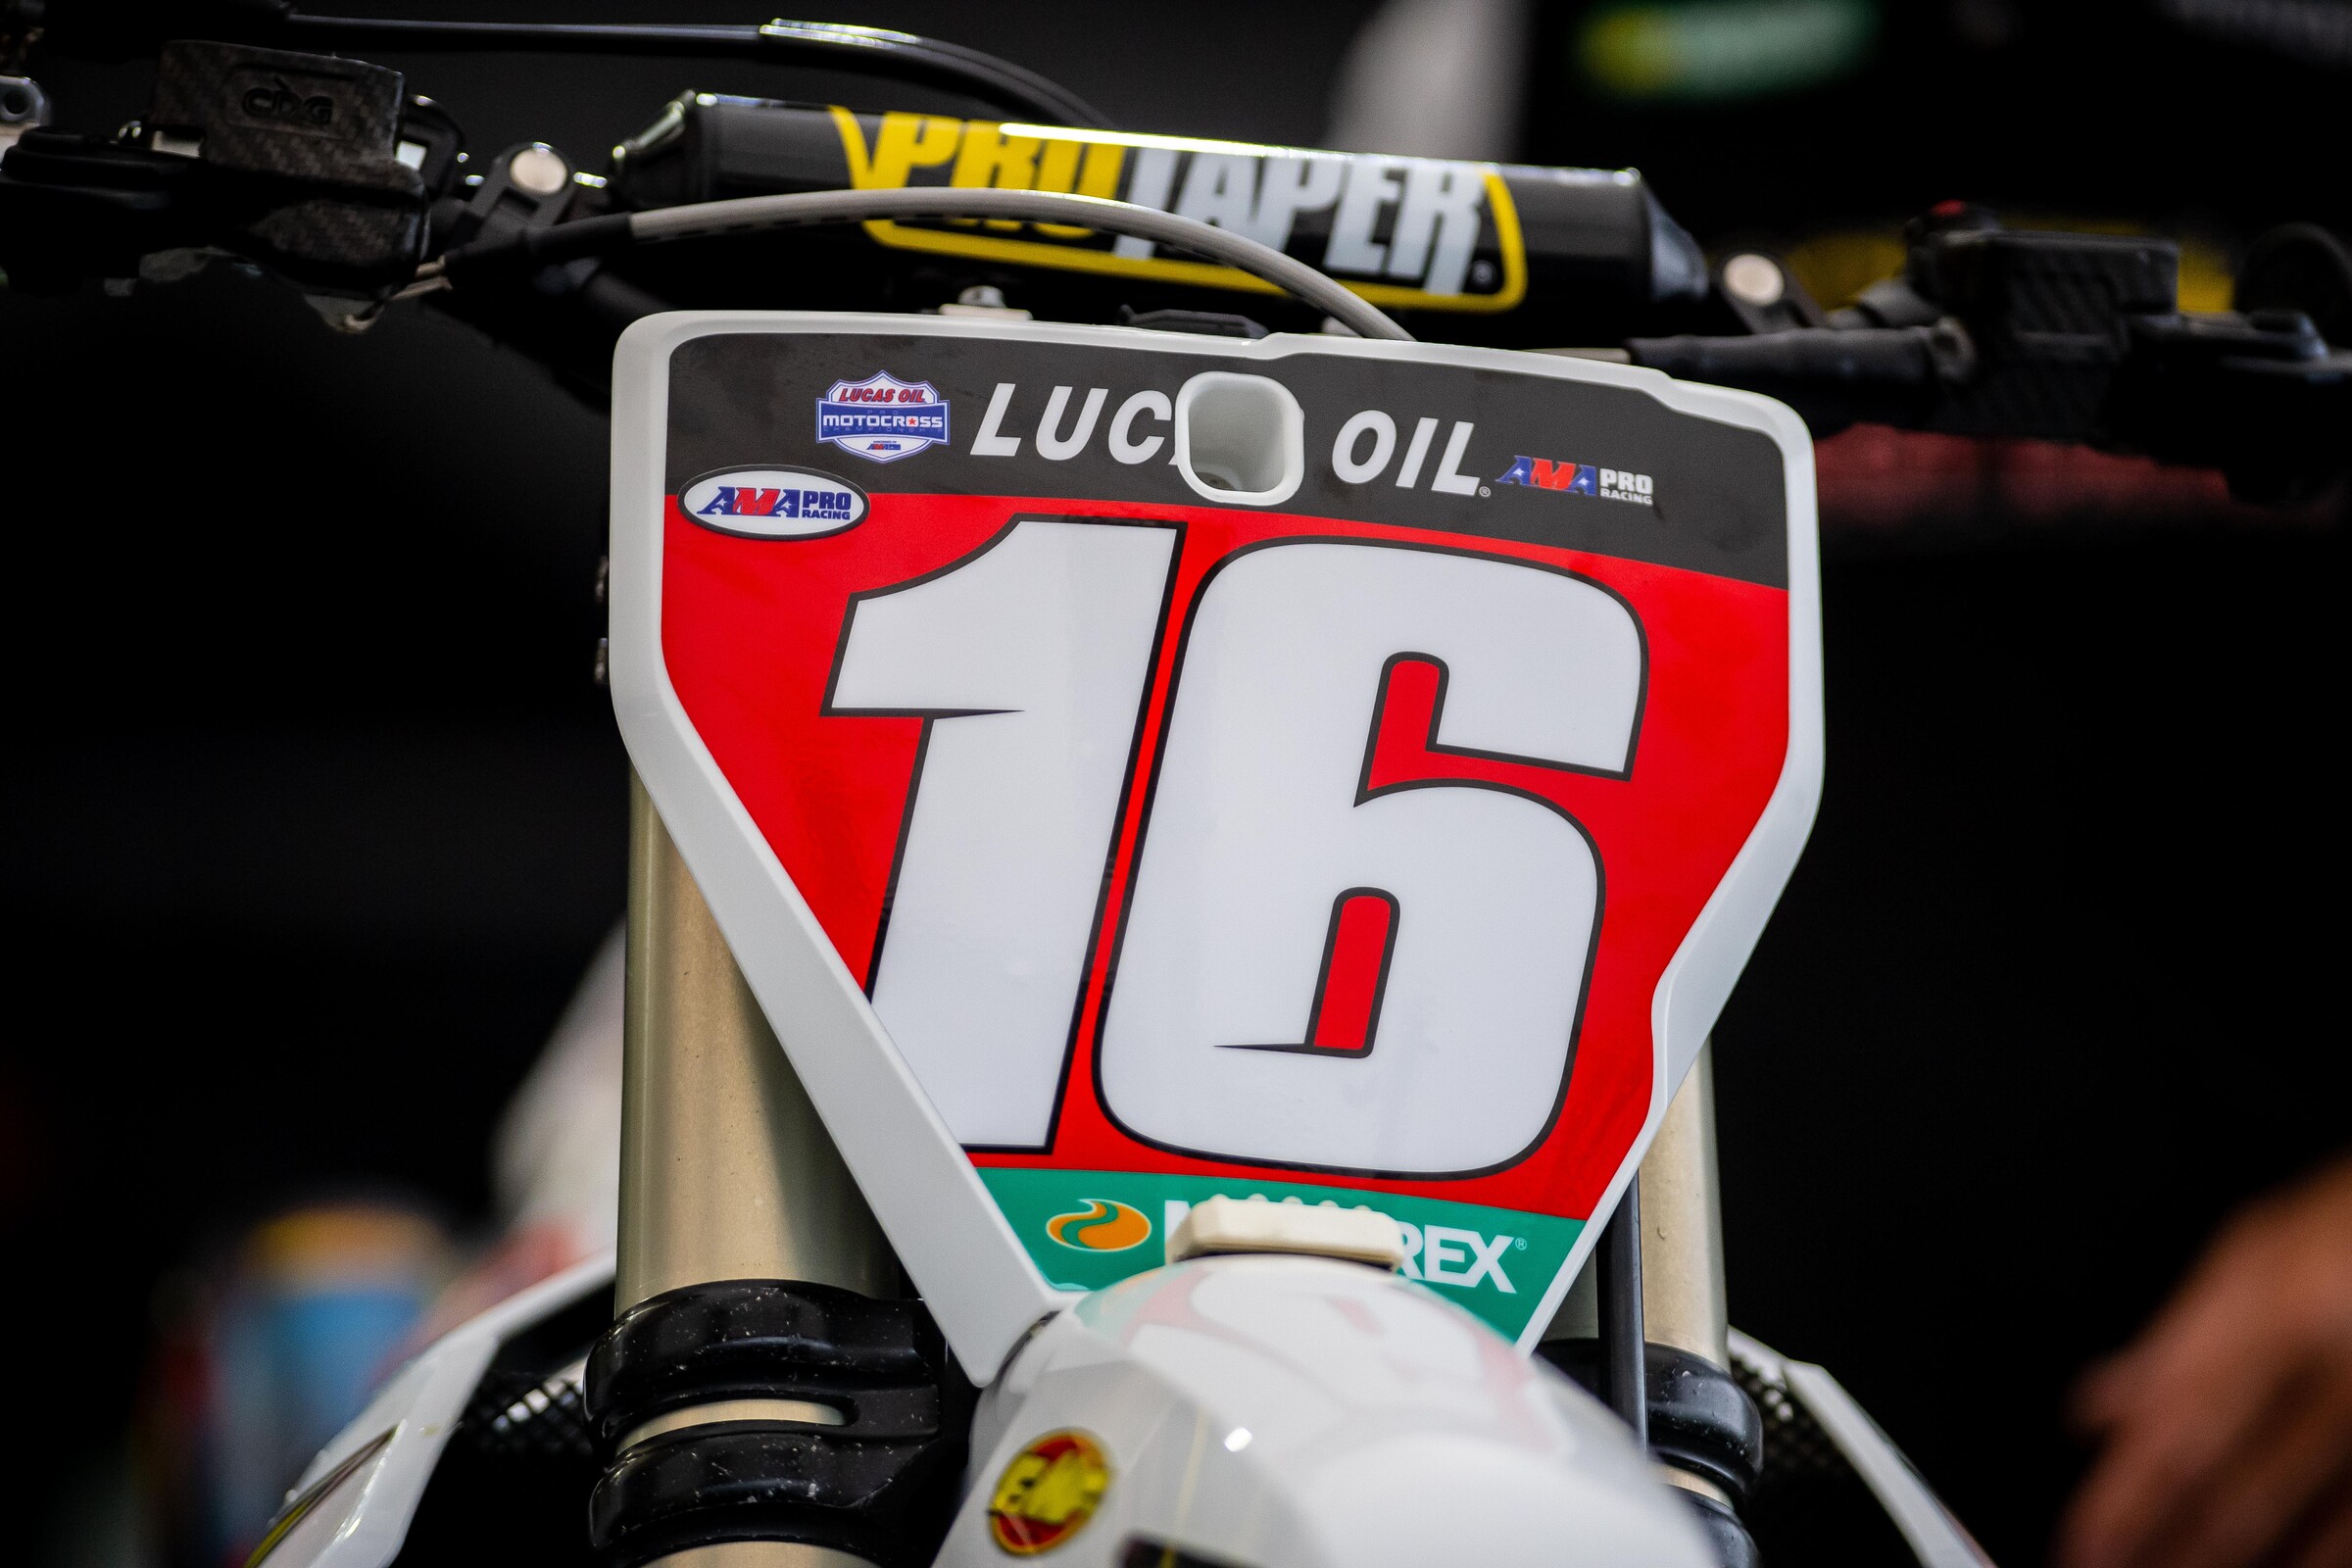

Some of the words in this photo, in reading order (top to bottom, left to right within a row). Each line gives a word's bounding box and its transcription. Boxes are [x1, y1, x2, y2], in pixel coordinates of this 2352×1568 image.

[839, 388, 895, 403] LUCAS
[898, 389, 925, 403] OIL
[823, 415, 943, 428] MOTOCROSS
[969, 382, 1178, 465] LUC
[1332, 410, 1481, 496] OIL
[1494, 455, 1596, 497] AMA
[1599, 467, 1653, 495] PRO
[697, 486, 801, 518] AMA
[803, 490, 852, 511] PRO
[1599, 487, 1653, 506] RACING
[802, 509, 851, 520] RACING
[820, 513, 1650, 1181] 16
